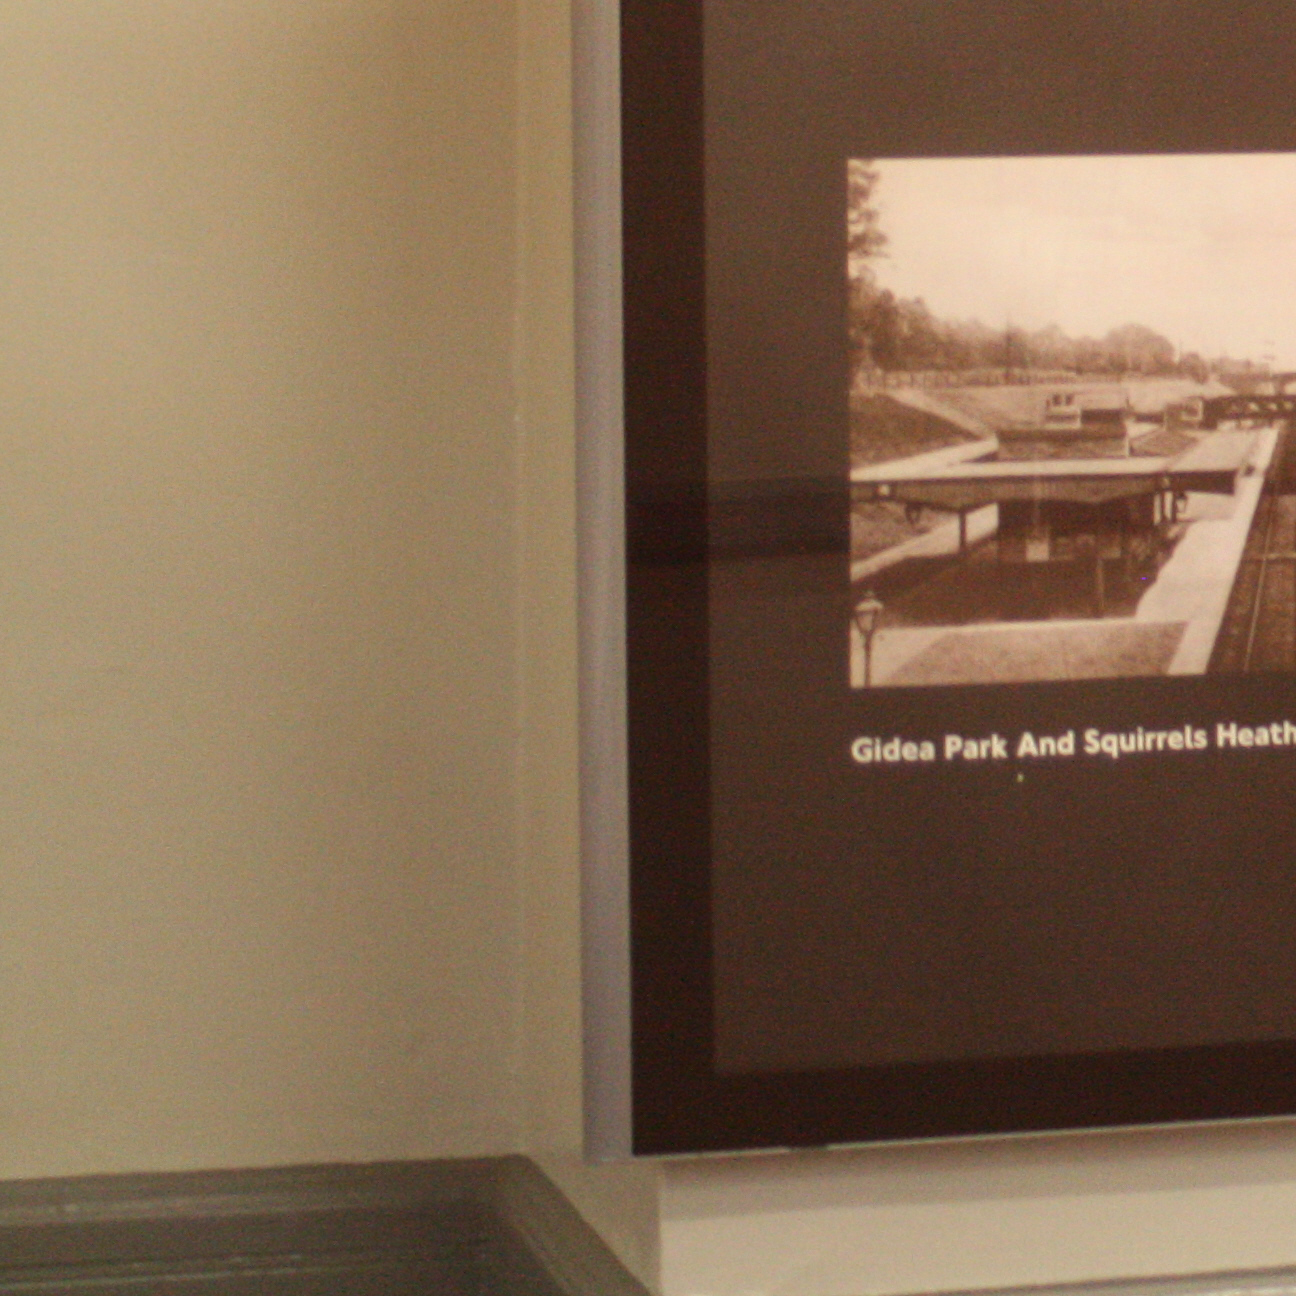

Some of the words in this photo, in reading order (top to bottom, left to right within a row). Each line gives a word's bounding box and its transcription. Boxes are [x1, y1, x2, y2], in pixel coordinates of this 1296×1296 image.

[850, 736, 936, 764] Gidea
[944, 733, 1008, 760] Park
[1016, 729, 1076, 758] And
[1083, 724, 1208, 760] Squirrels
